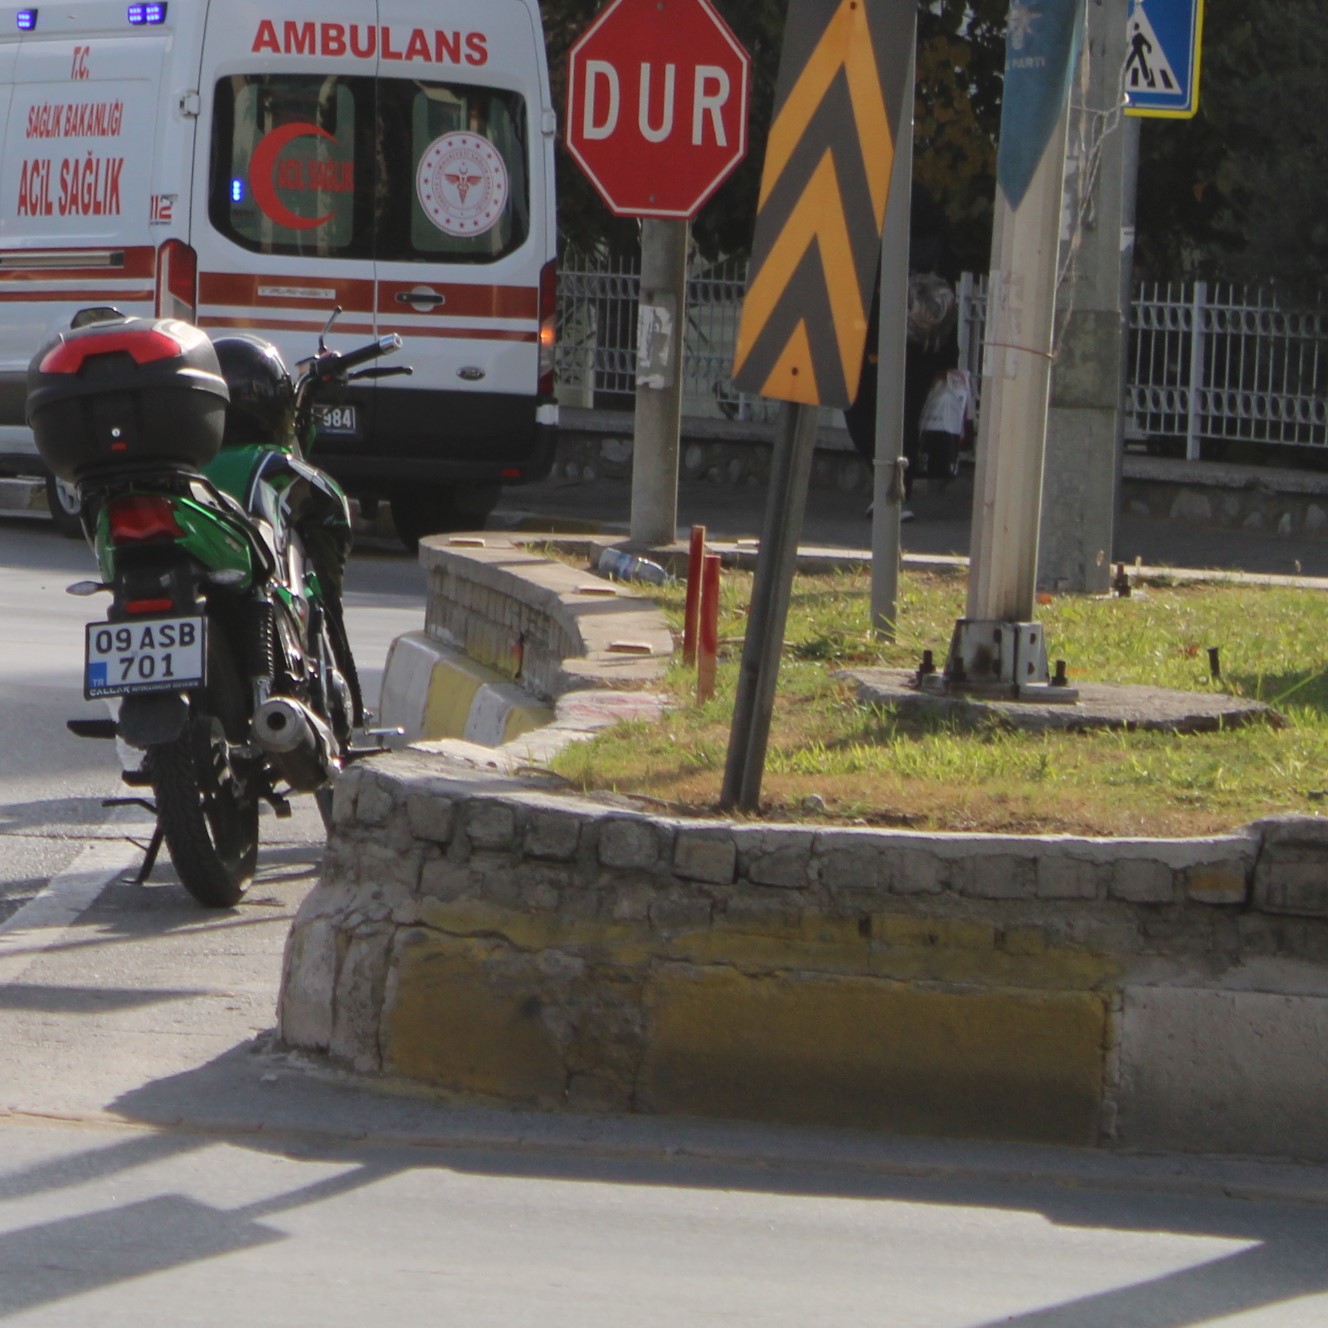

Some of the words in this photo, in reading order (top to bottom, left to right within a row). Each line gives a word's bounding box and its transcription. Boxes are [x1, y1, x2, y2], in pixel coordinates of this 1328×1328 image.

[71, 46, 90, 80] T.C.
[251, 19, 488, 66] AMBULANS
[26, 100, 64, 139] SAĞLIK
[64, 97, 124, 137] BAKANLIĞI
[583, 59, 730, 147] DUR
[58, 150, 124, 216] SAĞLIK
[96, 628, 132, 654] 09
[139, 622, 195, 650] ASB
[119, 653, 174, 681] 701
